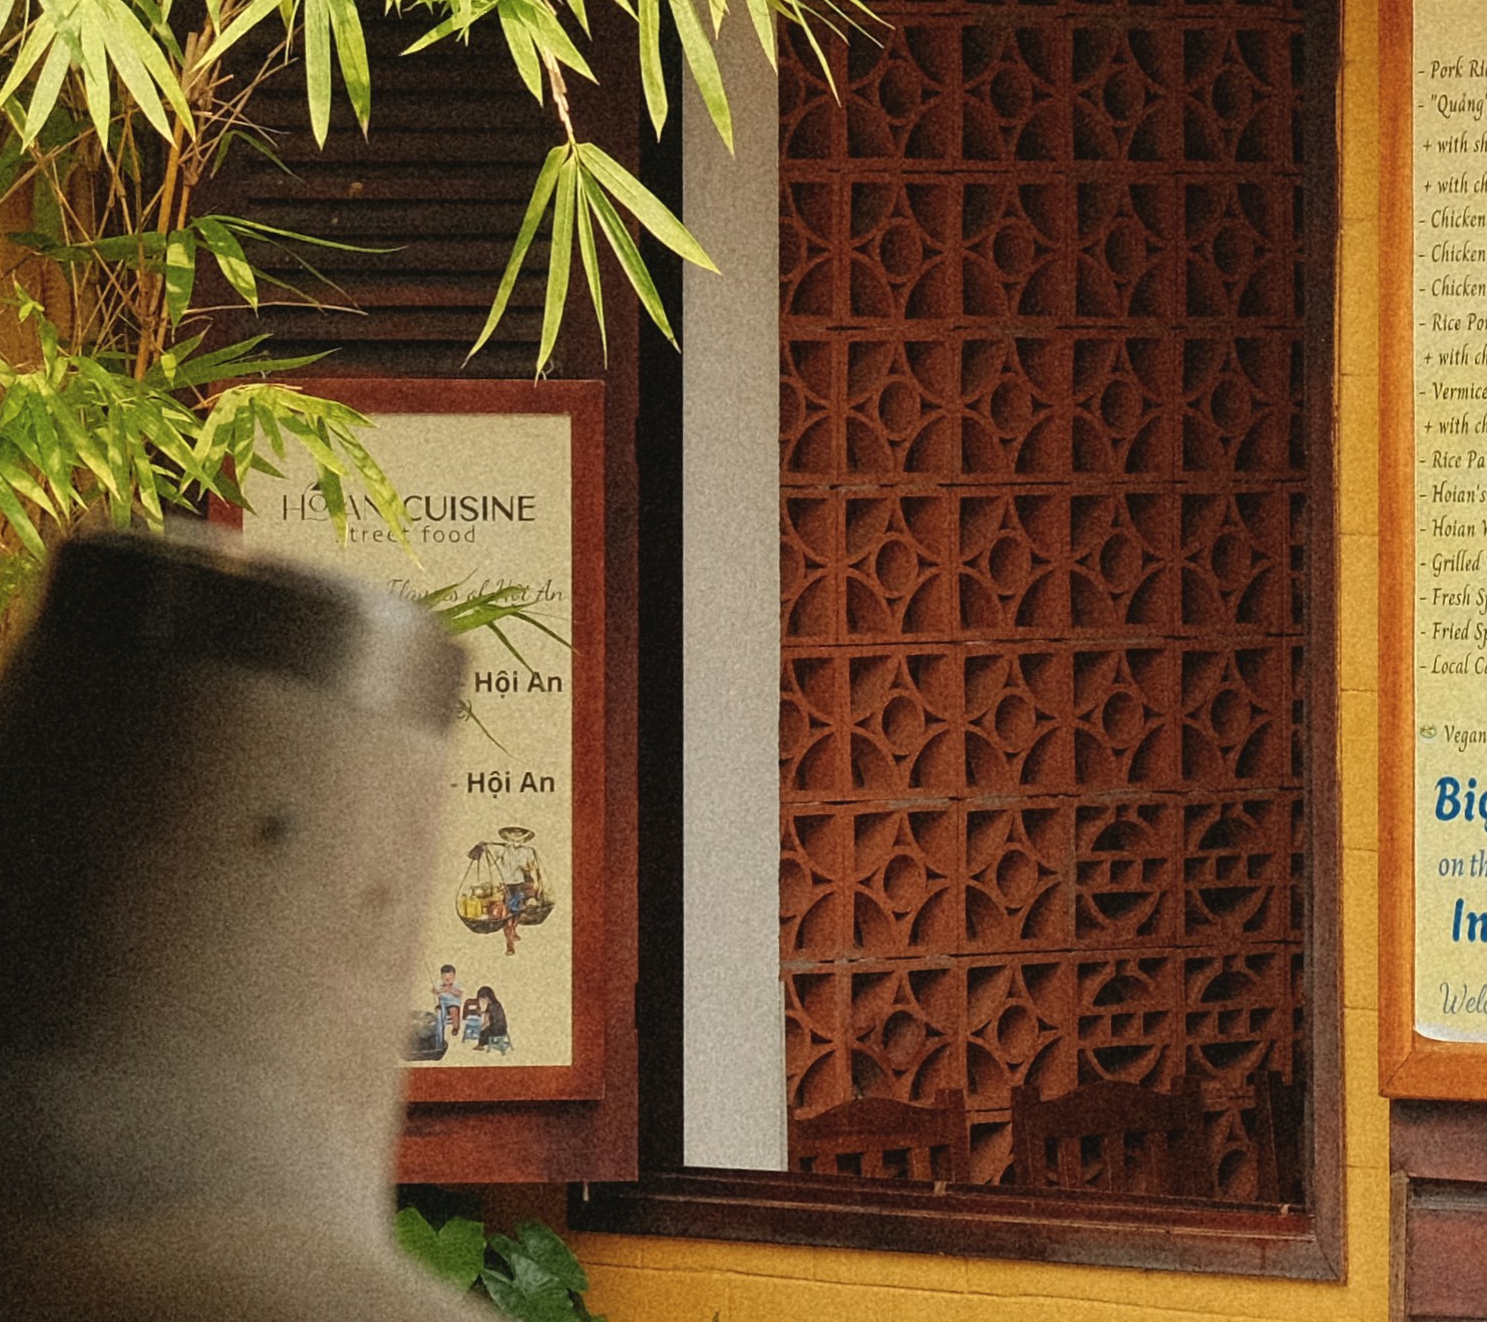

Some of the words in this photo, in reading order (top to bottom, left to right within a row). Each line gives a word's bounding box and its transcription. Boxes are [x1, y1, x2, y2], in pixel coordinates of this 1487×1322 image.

[1431, 55, 1464, 79] Pork
[1437, 130, 1468, 153] with
[1438, 171, 1468, 193] with
[1431, 205, 1486, 228] Chicken
[1431, 240, 1485, 263] Chicken
[1431, 274, 1486, 297] Chicken
[1432, 313, 1461, 331] Rice
[1439, 343, 1469, 366] with
[1439, 412, 1469, 435] with
[1432, 450, 1461, 469] Rice
[1432, 480, 1486, 503] Hoian's
[403, 495, 536, 522] CUISINE
[336, 526, 411, 544] treet
[422, 525, 476, 543] food
[1432, 515, 1476, 537] Hoian
[1432, 549, 1484, 578] Grilled
[1432, 584, 1470, 606] Fresh
[1433, 619, 1472, 640] Fried
[1431, 653, 1472, 675] Local
[475, 671, 518, 699] Hội
[527, 672, 563, 692] An
[1445, 725, 1487, 752] Vegan
[467, 771, 510, 799] Hội
[520, 772, 555, 793] An
[1439, 856, 1464, 877] on
